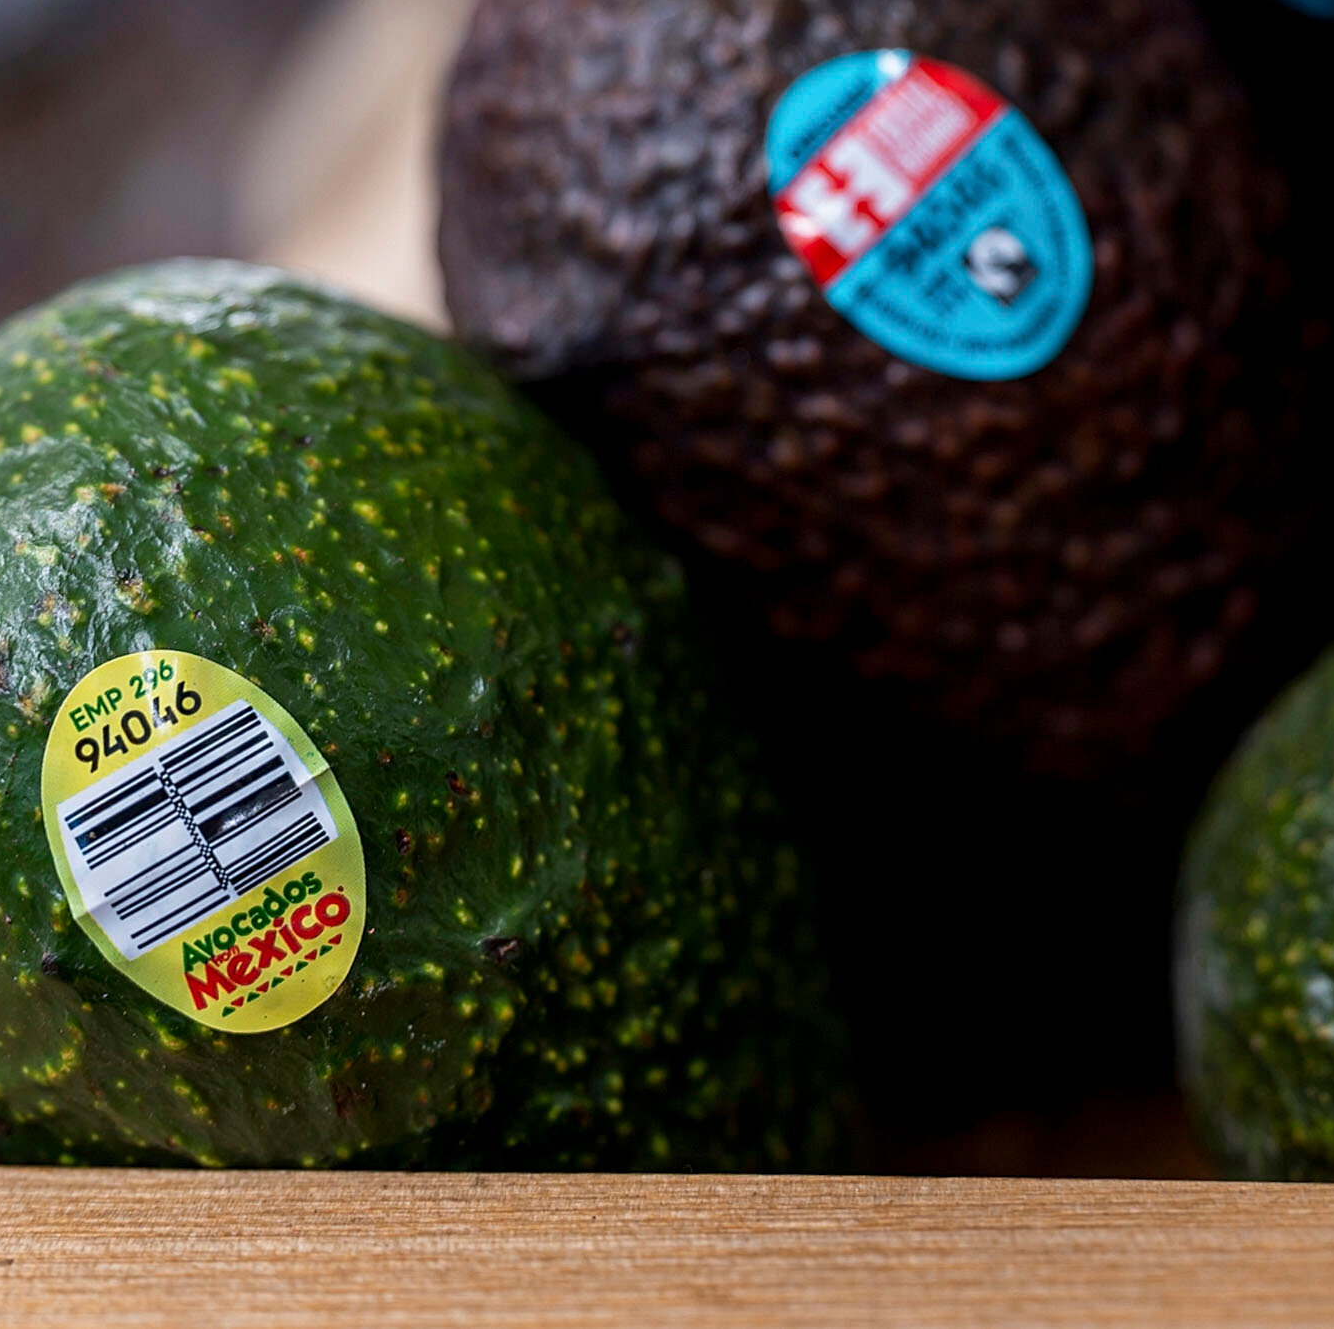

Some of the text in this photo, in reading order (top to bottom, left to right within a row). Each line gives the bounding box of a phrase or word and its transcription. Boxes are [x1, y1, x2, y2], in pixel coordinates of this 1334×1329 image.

[69, 659, 173, 732] EMP 296
[75, 681, 202, 773] 94046
[182, 871, 322, 973] Avocados
[185, 892, 351, 1010] Mexico
